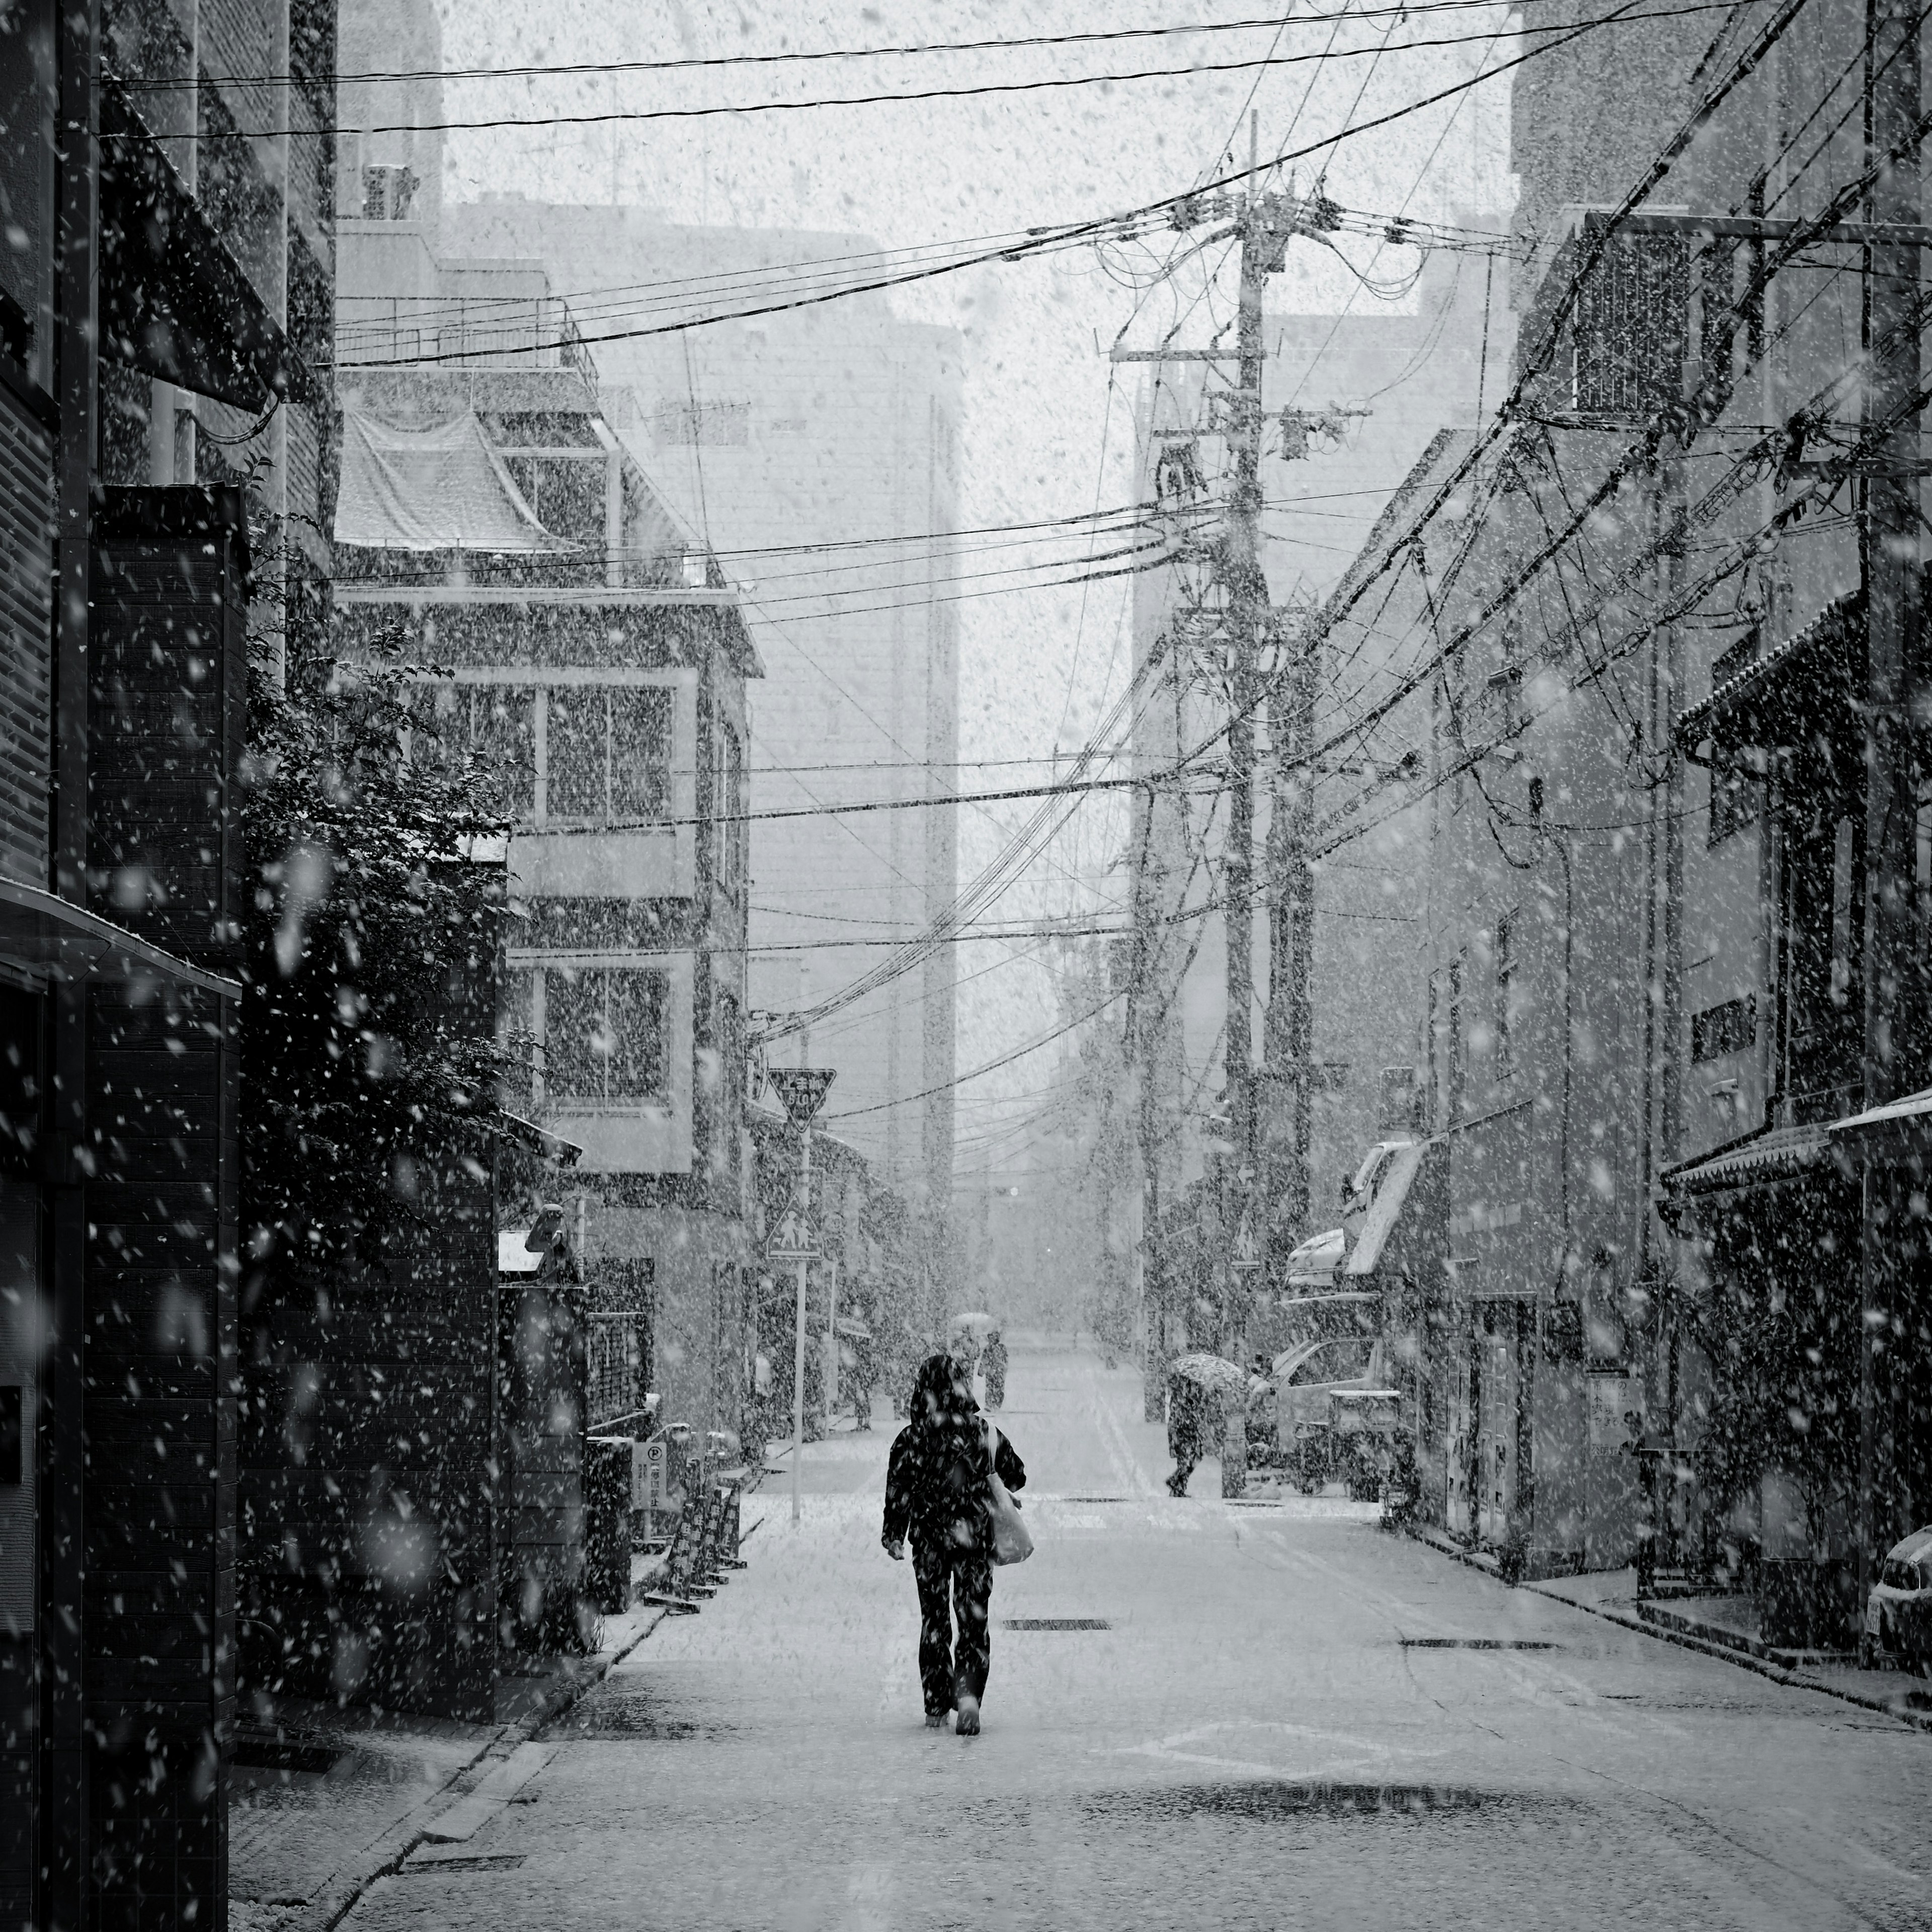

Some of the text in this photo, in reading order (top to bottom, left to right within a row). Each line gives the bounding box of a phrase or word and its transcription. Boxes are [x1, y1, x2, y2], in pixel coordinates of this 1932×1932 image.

[781, 1076, 826, 1090] 止まれ
[787, 1093, 817, 1105] STOP
